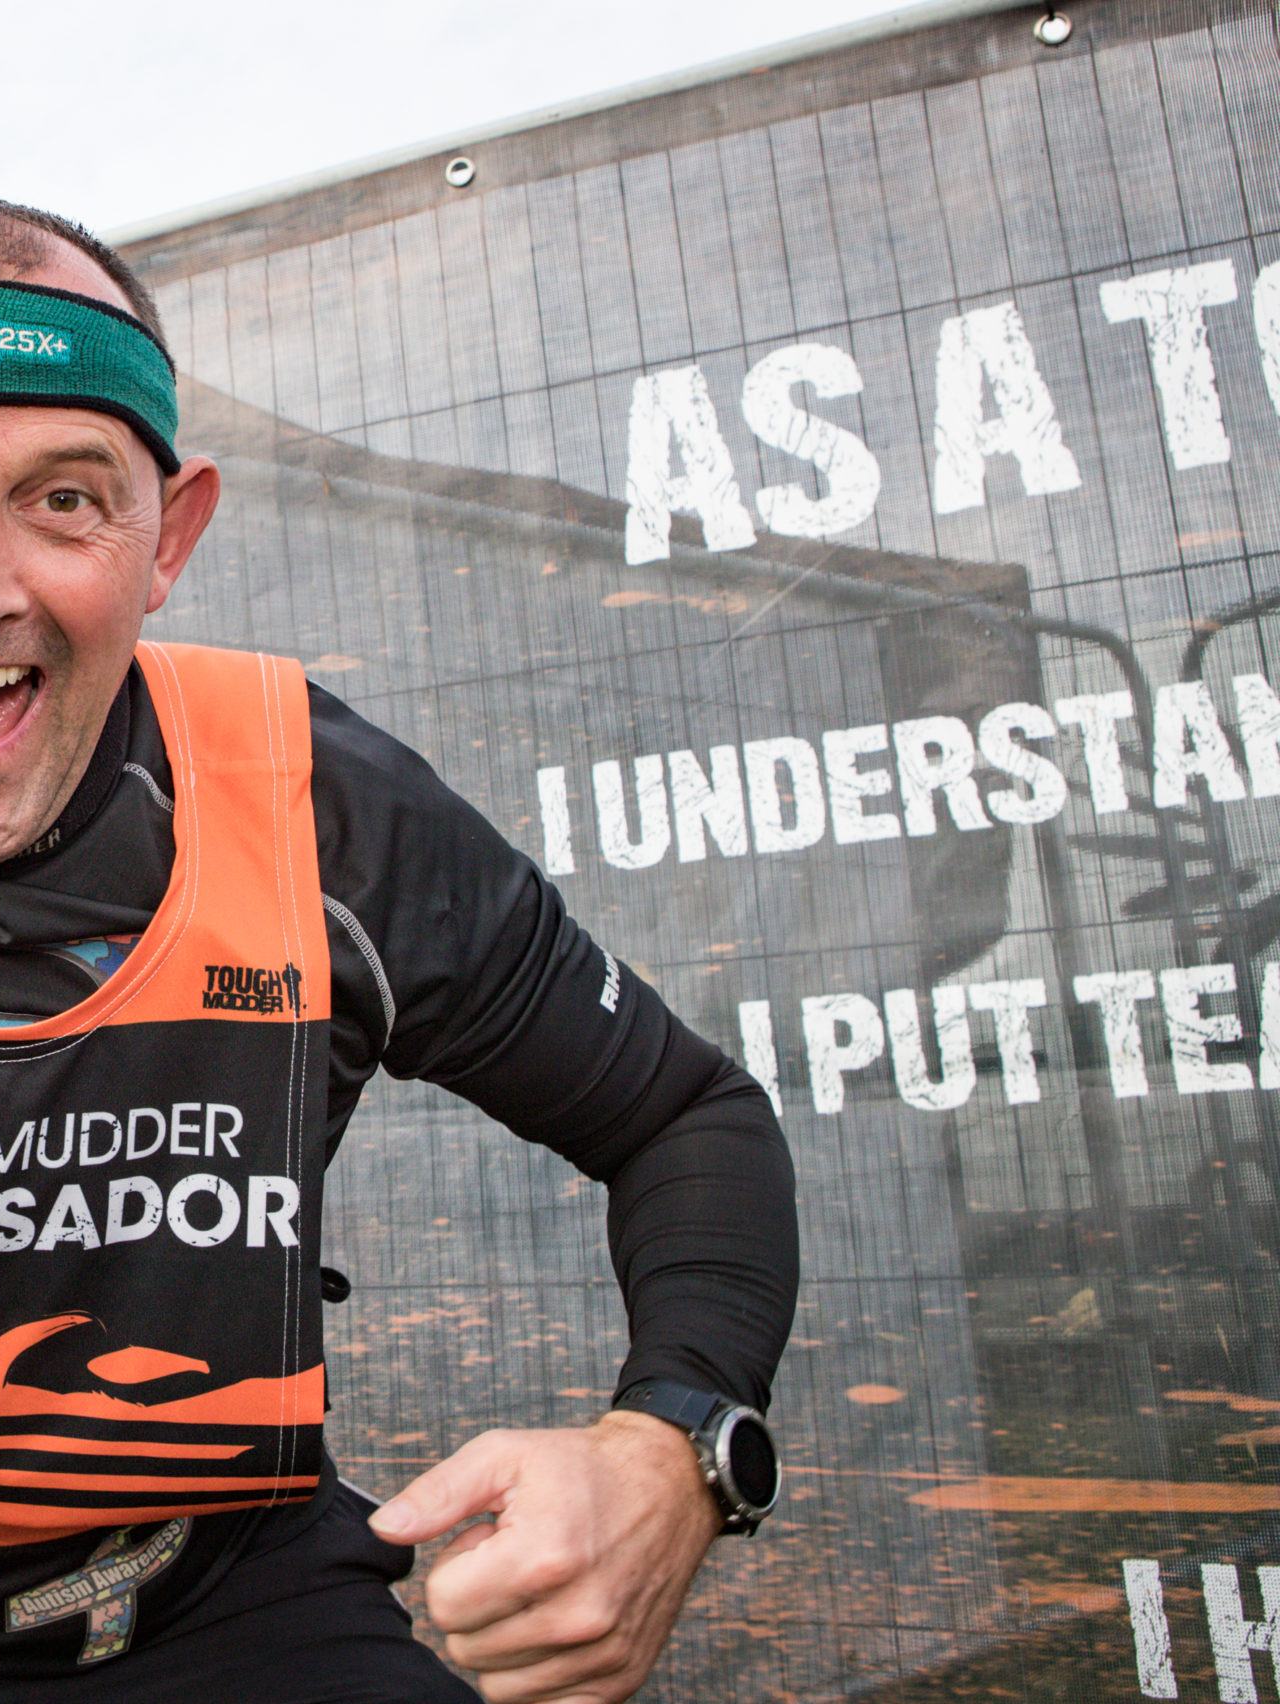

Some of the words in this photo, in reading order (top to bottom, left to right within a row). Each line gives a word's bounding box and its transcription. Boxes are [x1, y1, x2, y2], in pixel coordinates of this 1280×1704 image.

[0, 327, 68, 356] 25X+
[626, 341, 880, 566] AS
[934, 301, 1082, 515] A
[1099, 258, 1280, 471] T
[536, 766, 575, 876] I
[202, 990, 283, 1015] MUDDER
[205, 965, 283, 996] TOUGH
[738, 1000, 784, 1118] I
[802, 979, 1046, 1115] PUT
[1073, 962, 1280, 1098] TE
[20, 1579, 95, 1615] Autism
[91, 1519, 182, 1591] Awareness
[1123, 1559, 1178, 1699] I
